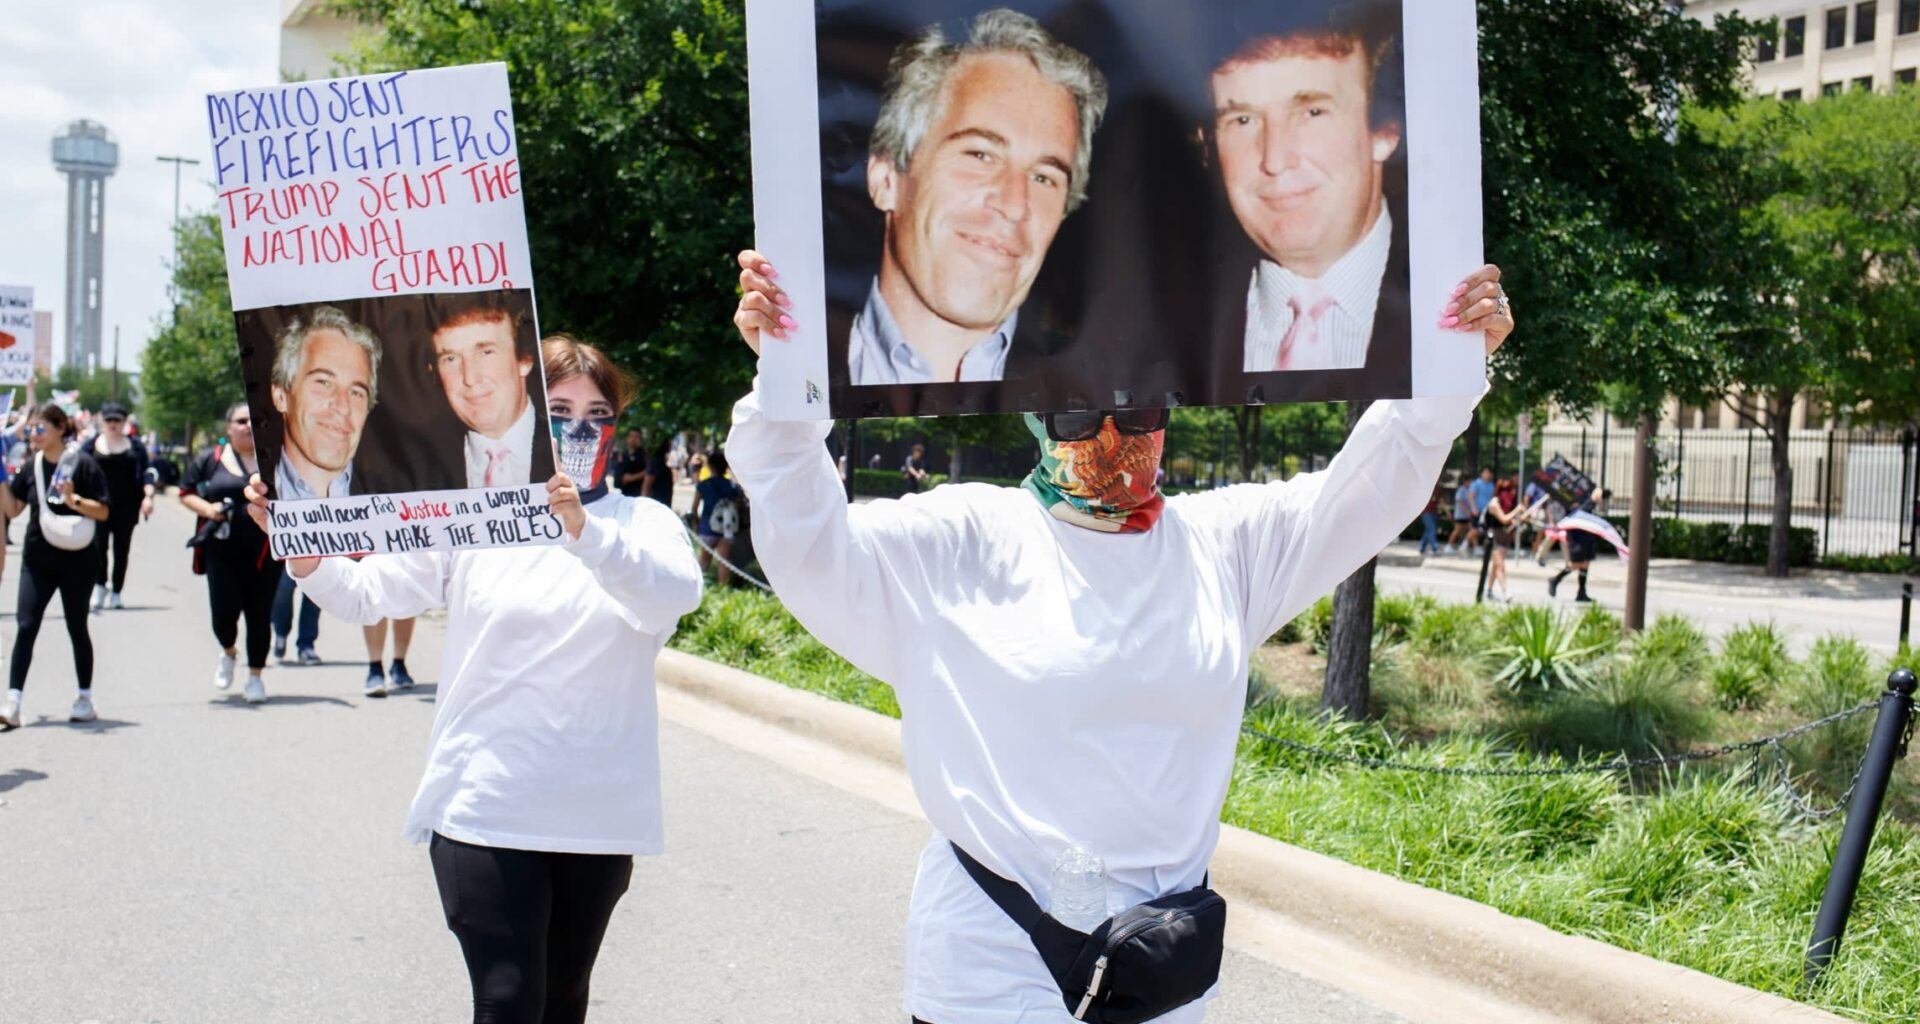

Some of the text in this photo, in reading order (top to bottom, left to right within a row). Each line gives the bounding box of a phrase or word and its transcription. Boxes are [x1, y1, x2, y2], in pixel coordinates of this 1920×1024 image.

[206, 72, 408, 138] MEXICO SENT
[214, 109, 512, 185] FIREFIGHTERS
[219, 159, 520, 228] TRUMP SENT THE
[243, 218, 422, 268] NATIONAL
[371, 241, 513, 293] GUARD!
[272, 513, 563, 557] CRIMINALS MAKE THE RULES
[303, 504, 333, 523] will
[335, 505, 370, 523] never
[399, 499, 452, 522] Justice
[455, 501, 469, 515] in
[473, 502, 483, 514] a
